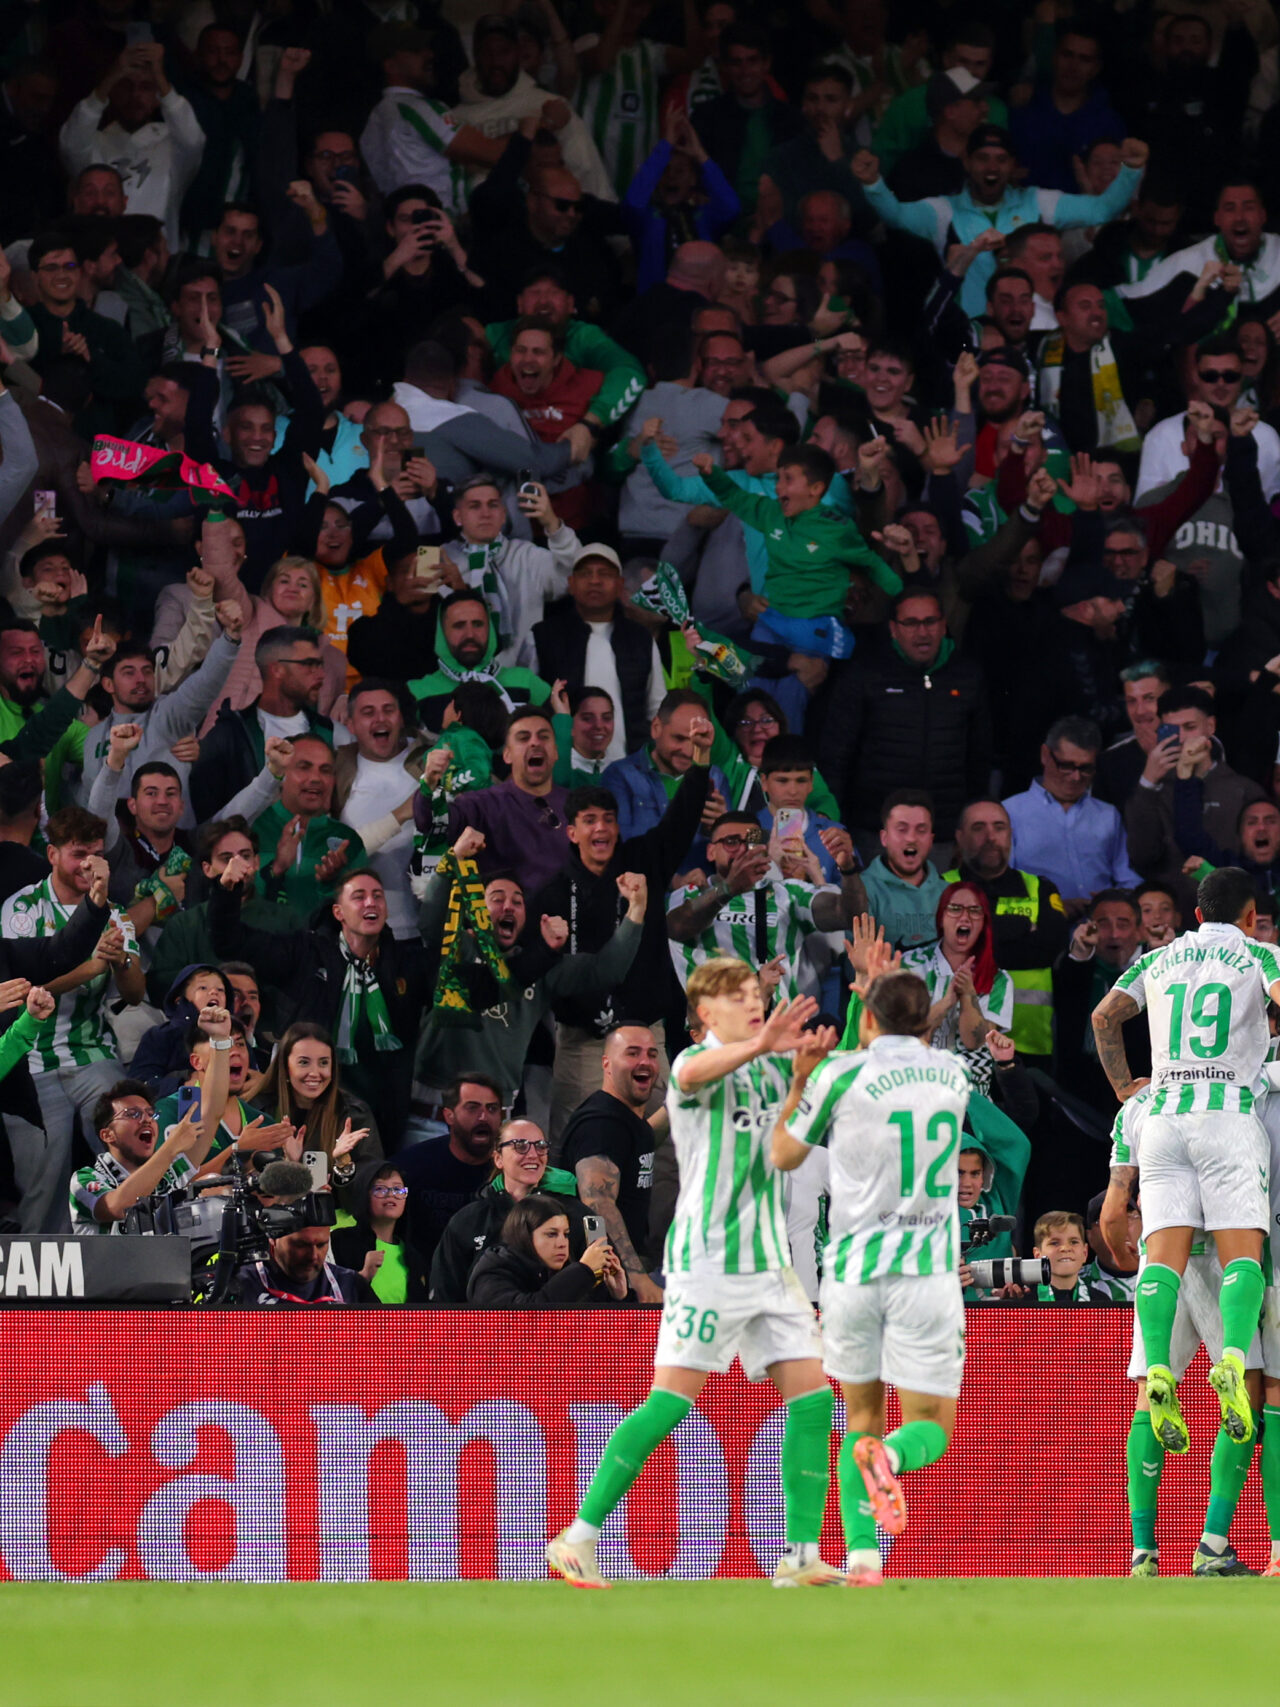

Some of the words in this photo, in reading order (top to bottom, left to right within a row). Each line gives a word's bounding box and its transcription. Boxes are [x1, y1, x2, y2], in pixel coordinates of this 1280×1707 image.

[1165, 982, 1232, 1060] 19
[1171, 1066, 1236, 1081] trainline
[887, 1110, 958, 1198] 12
[0, 1241, 85, 1297] AM
[676, 1305, 719, 1344] 36
